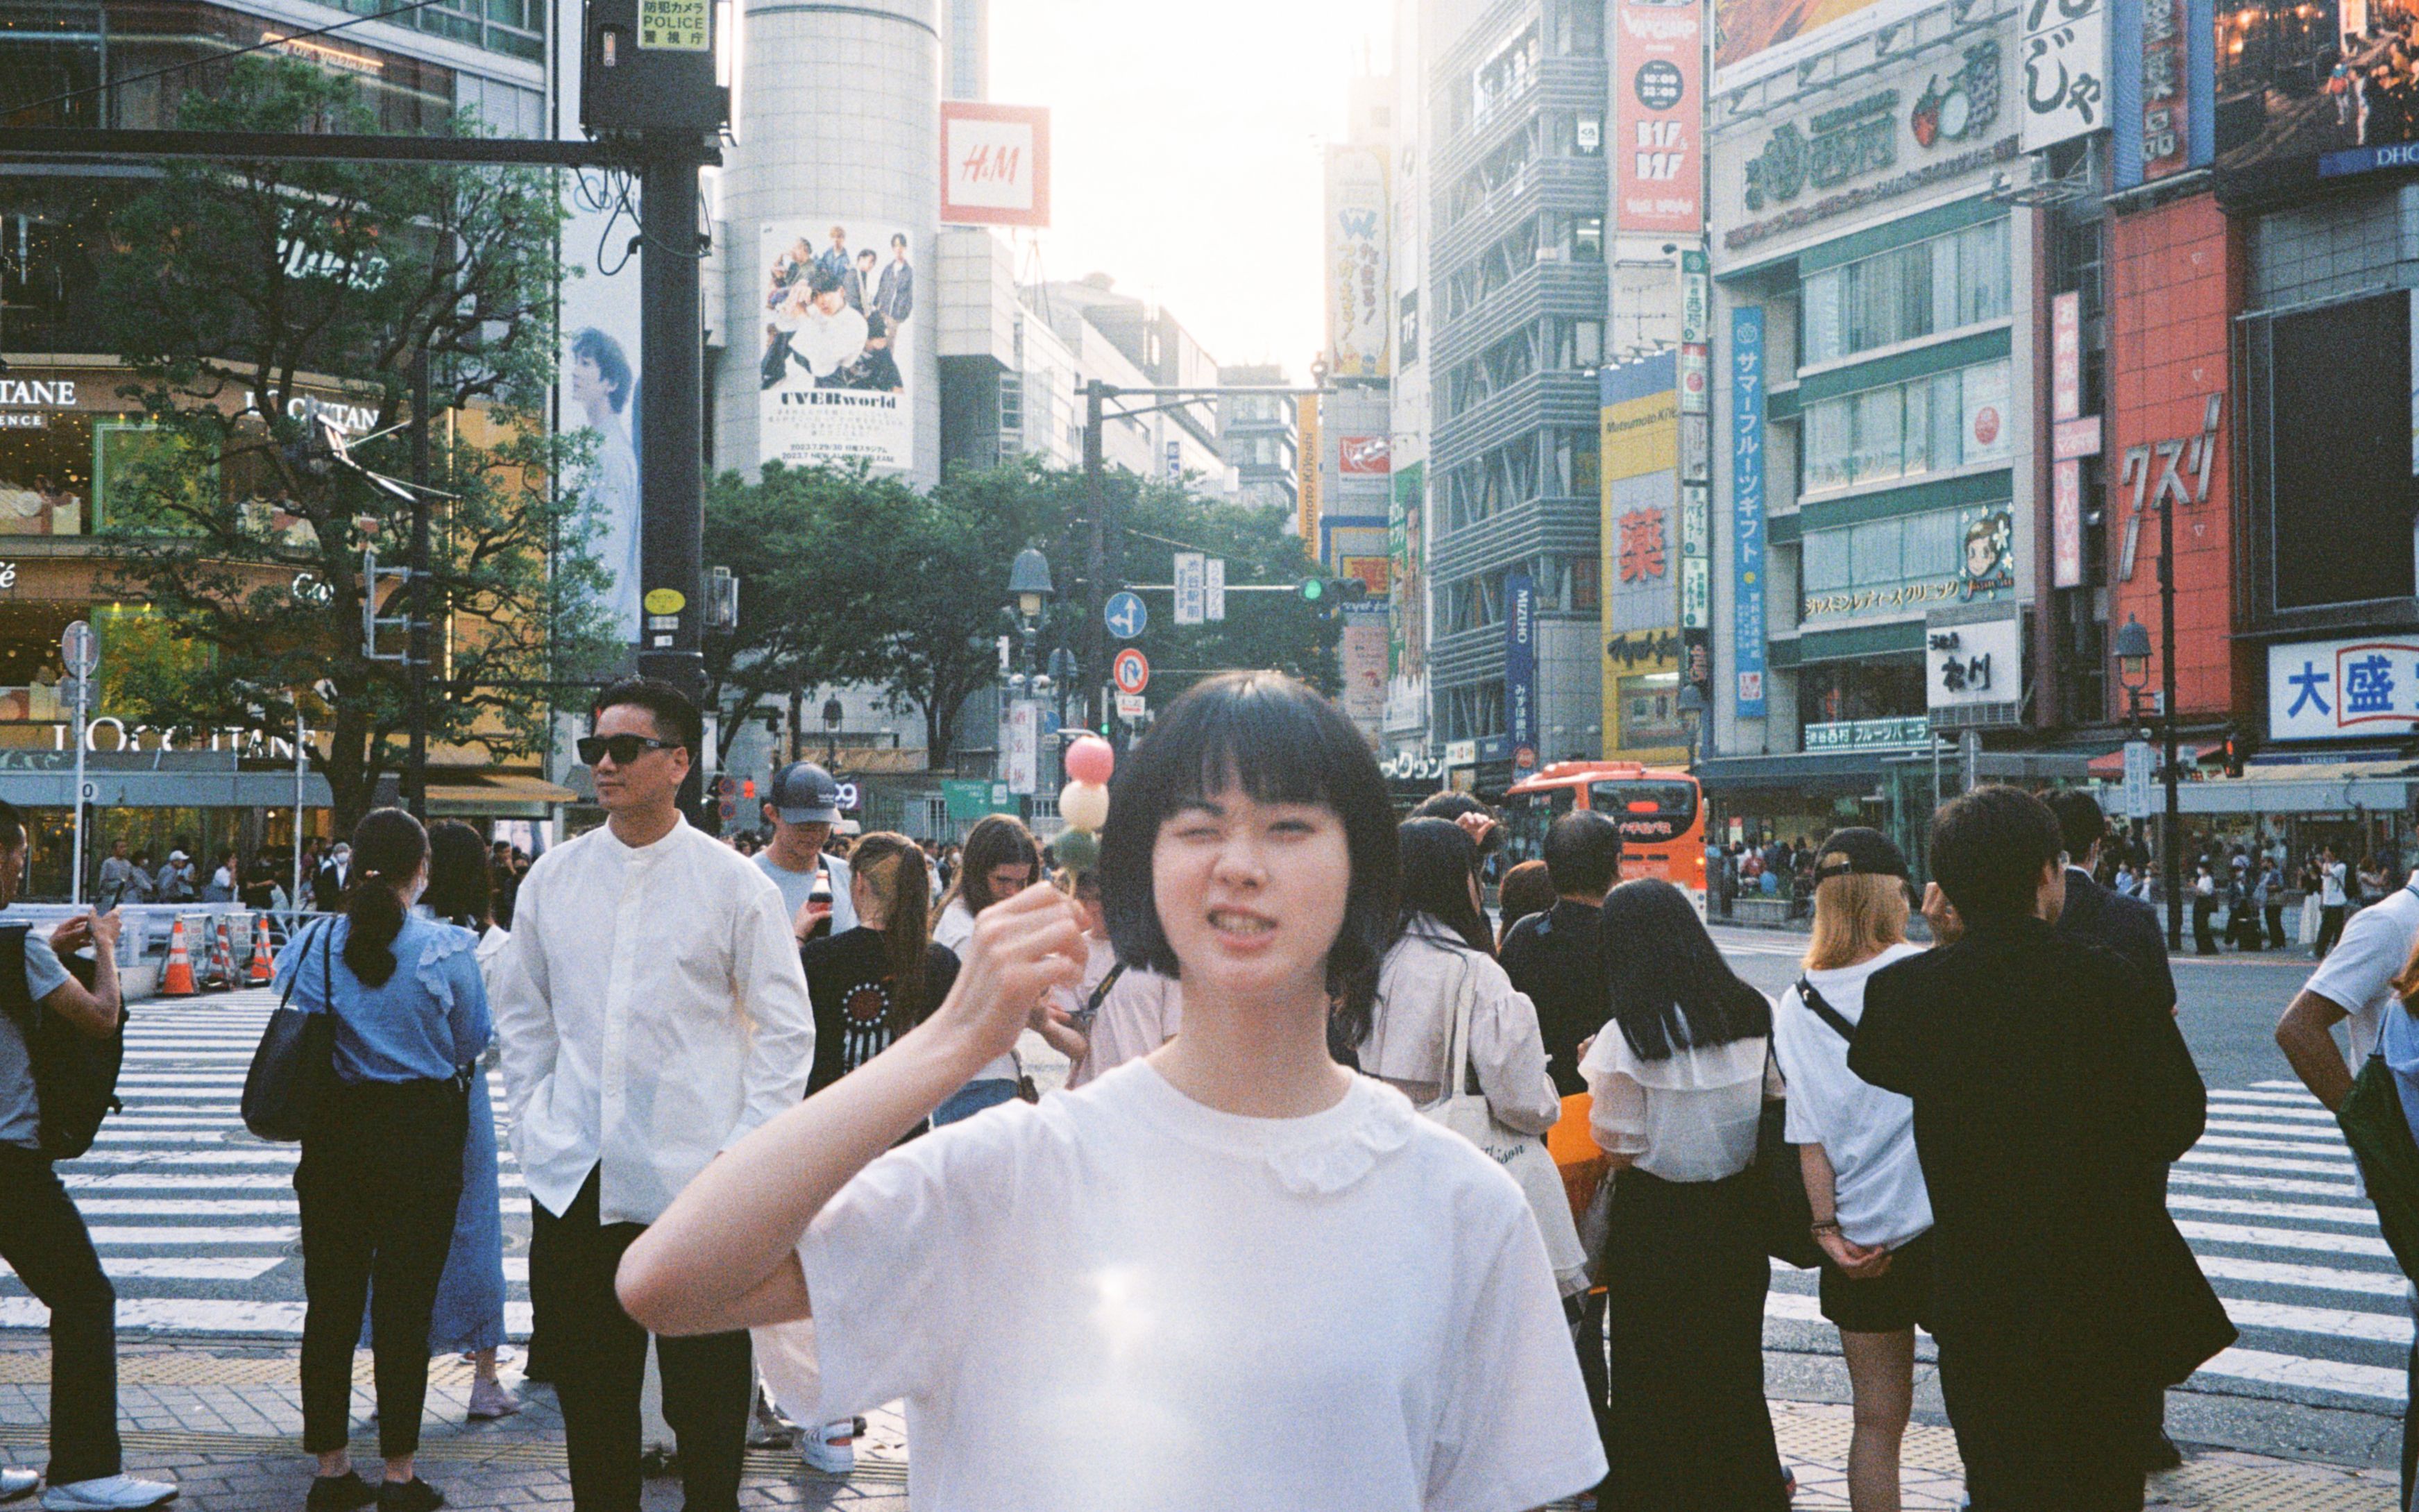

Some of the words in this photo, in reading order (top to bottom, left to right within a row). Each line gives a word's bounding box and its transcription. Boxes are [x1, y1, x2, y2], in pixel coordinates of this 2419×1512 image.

[643, 15, 703, 29] POLICE
[644, 1, 704, 14] 防犯カメラ
[644, 30, 703, 44] 警視庁
[962, 144, 1020, 185] H&M
[781, 391, 897, 409] UVERworld
[1302, 432, 1314, 484] KiYoshi
[1737, 351, 1759, 563] サマーフルーツギフト
[2119, 391, 2222, 583] クスリ
[1619, 506, 1665, 584] 薬
[1517, 590, 1528, 644] MIZUHO
[1805, 580, 1959, 617] ジャスミンレディースクリニック
[2287, 654, 2419, 719] 大盛
[1808, 727, 1849, 744] 渋谷西村
